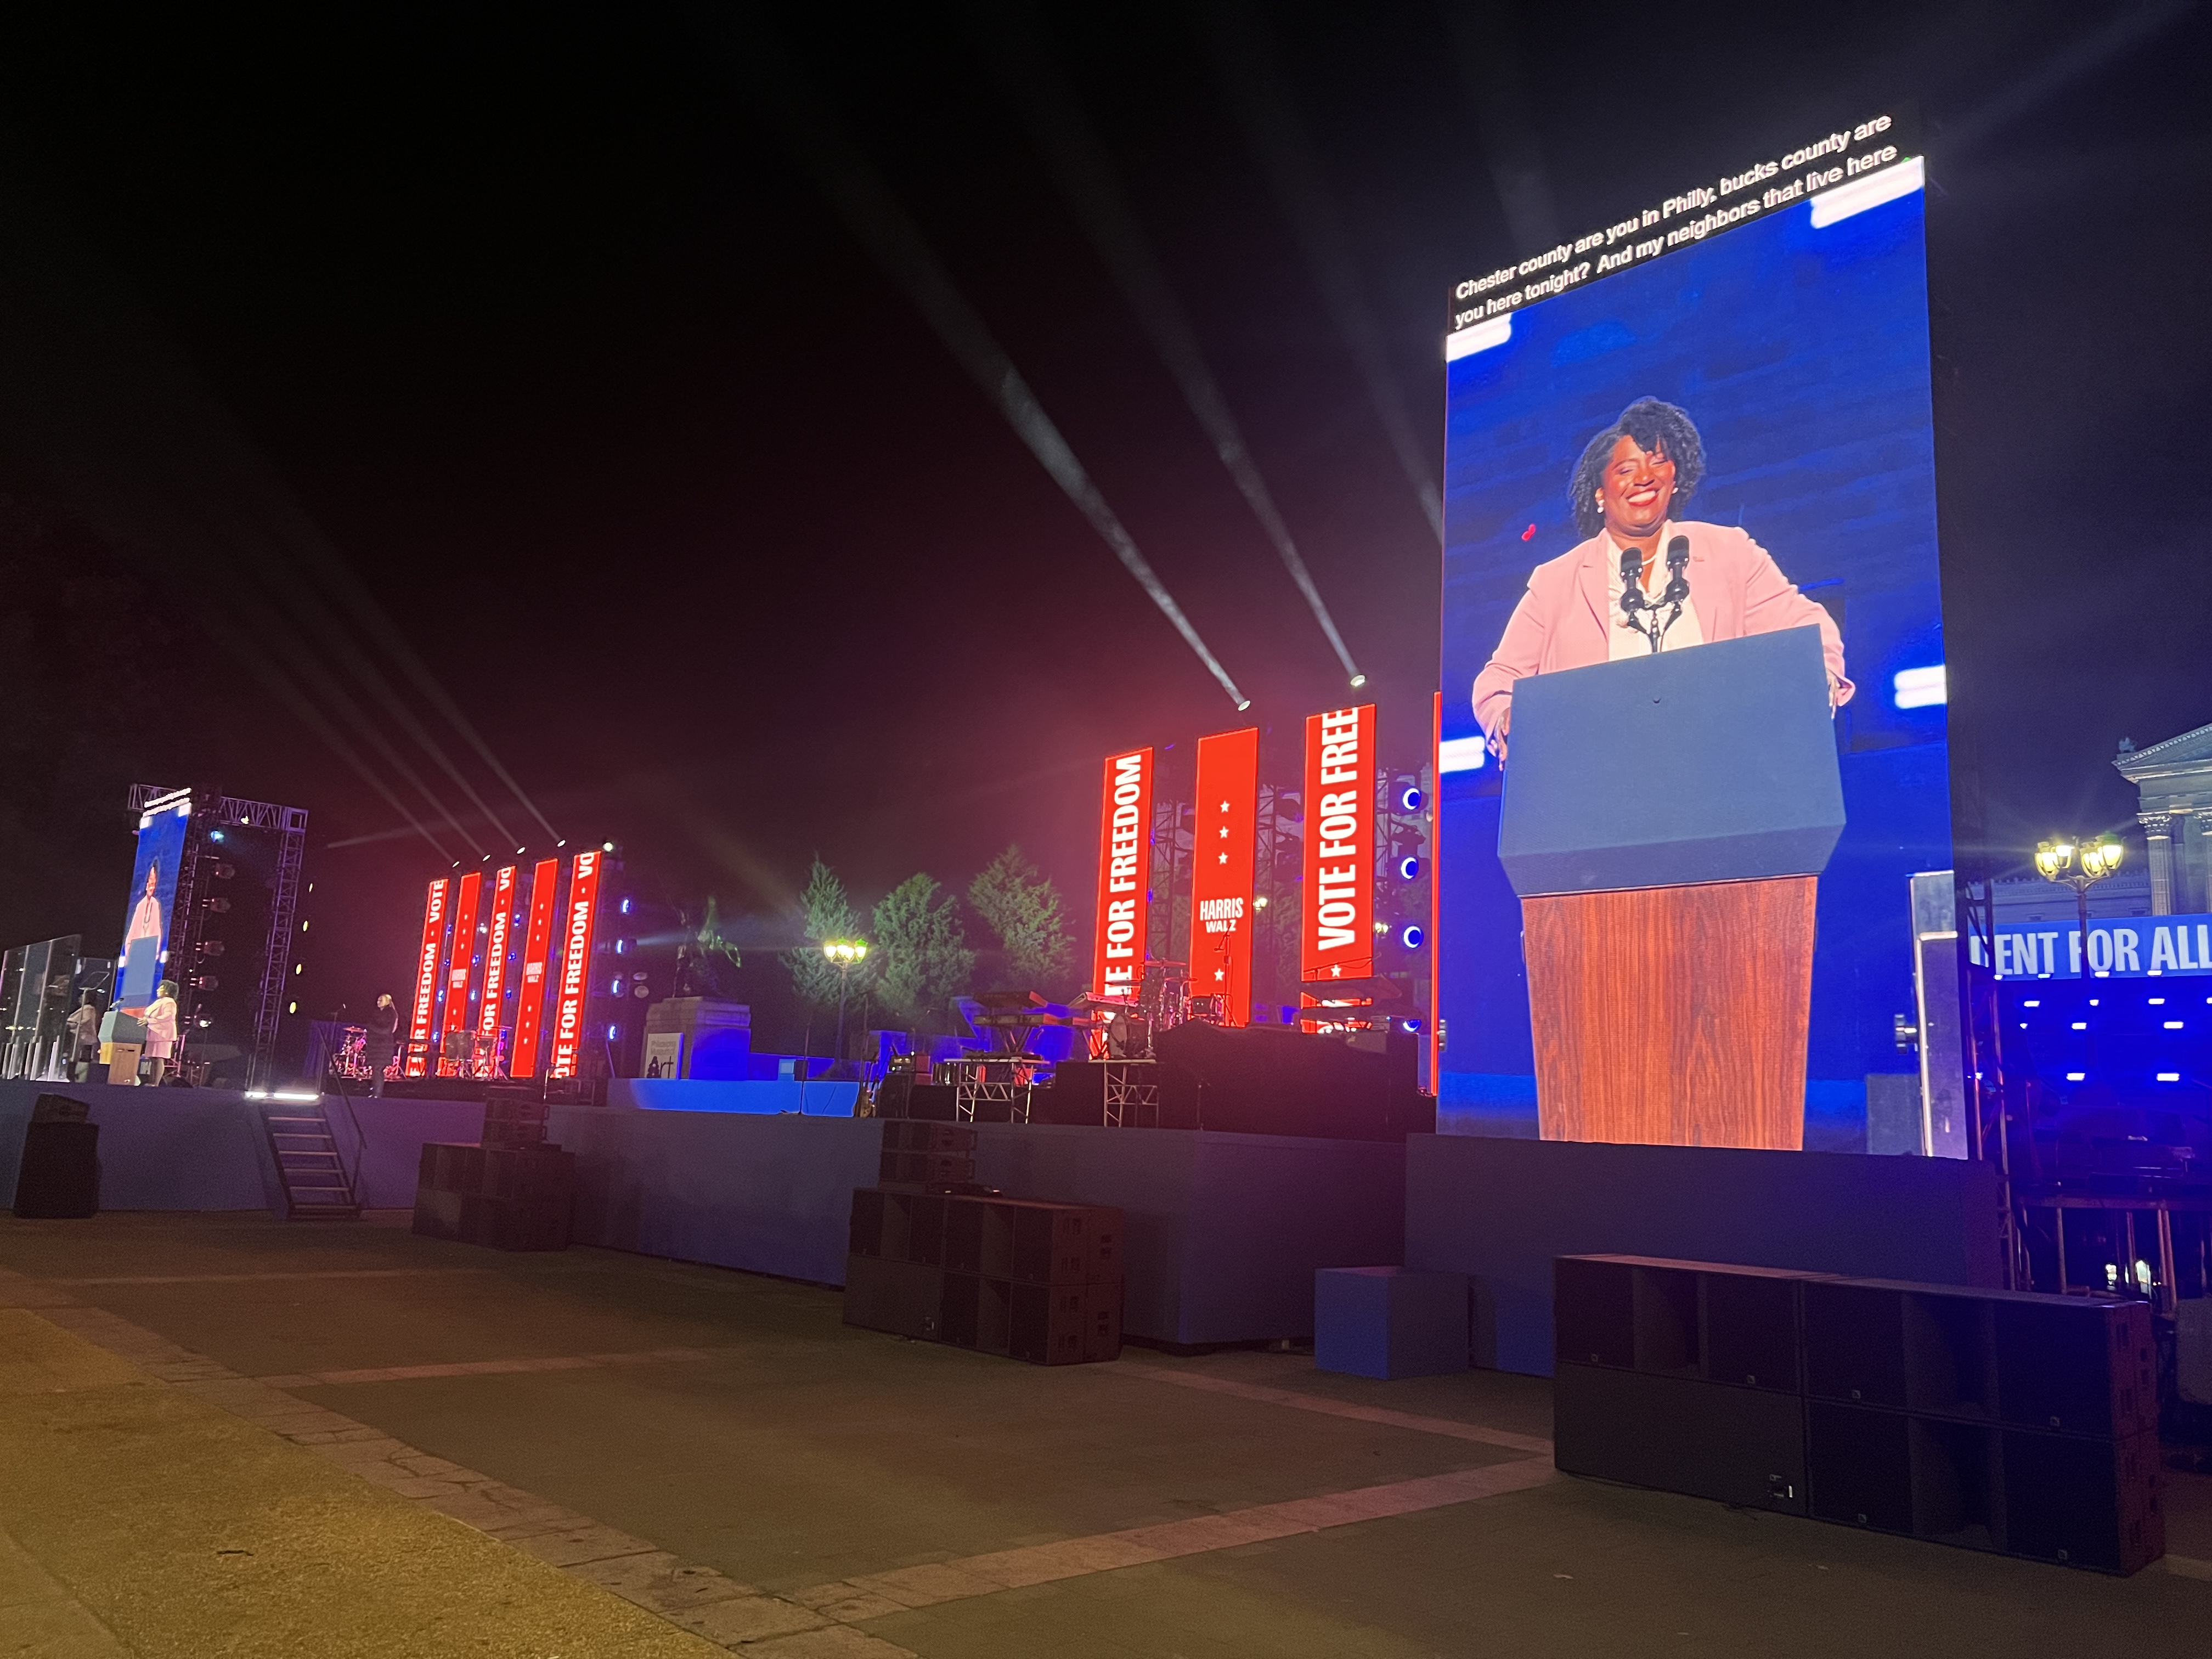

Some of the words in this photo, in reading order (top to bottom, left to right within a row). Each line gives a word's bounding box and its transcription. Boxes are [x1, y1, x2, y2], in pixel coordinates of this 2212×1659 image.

[1455, 266, 1517, 299] Chester
[1519, 244, 1573, 275] county
[1575, 233, 1604, 253] are
[1606, 218, 1639, 245] you
[1643, 210, 1660, 227] in
[1720, 161, 1779, 196] bucks
[1781, 131, 1851, 170] county
[1854, 116, 1892, 140] are
[1455, 306, 1484, 329] you
[1487, 292, 1522, 314] here
[1525, 262, 1590, 300] tonight?
[1596, 245, 1633, 273] And
[1636, 236, 1664, 258] my
[1668, 200, 1760, 246] neighbors
[1763, 179, 1804, 208] that
[1807, 167, 1843, 192] live
[1847, 146, 1897, 176] here
[1321, 707, 1358, 785] FREE
[1110, 755, 1141, 893] FREEDOM
[1320, 791, 1357, 857] FOR
[565, 901, 589, 995] FREEDOM
[1107, 900, 1135, 958] FOR
[1200, 898, 1244, 921] HARRIS
[1206, 919, 1236, 933] WALZ
[1318, 865, 1356, 950] VOTE
[416, 944, 436, 1024] FREEDOM
[429, 881, 444, 923] VOTE
[487, 912, 506, 999] FREEDOM
[2069, 929, 2140, 973] FOR
[2151, 925, 2212, 970] ALL
[560, 1000, 578, 1039] FOR
